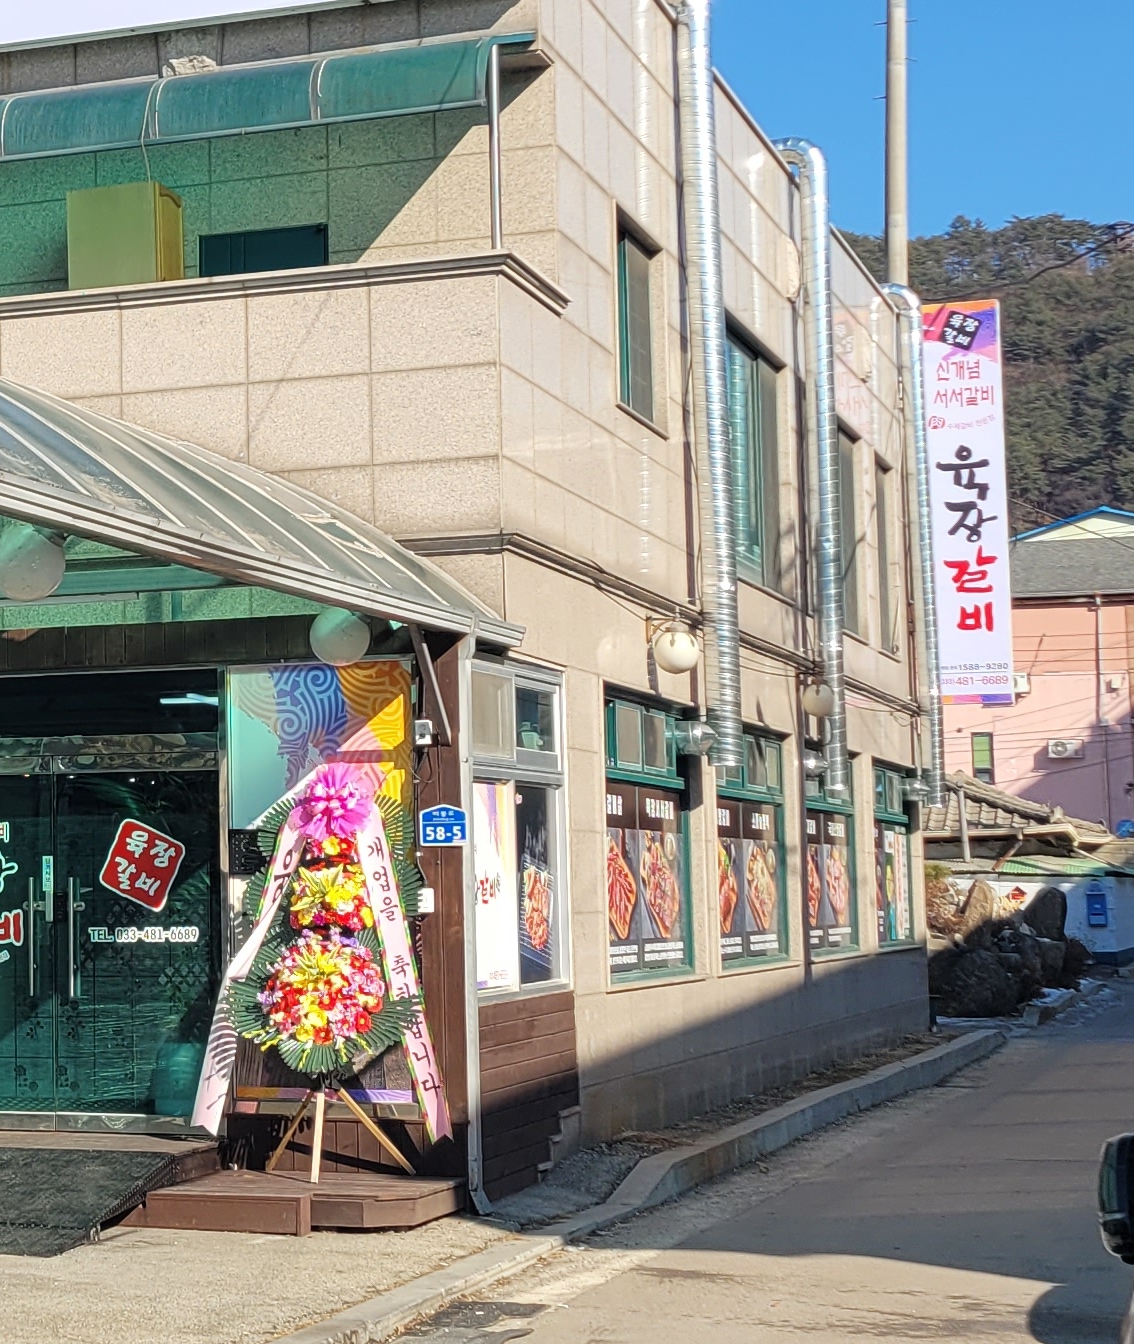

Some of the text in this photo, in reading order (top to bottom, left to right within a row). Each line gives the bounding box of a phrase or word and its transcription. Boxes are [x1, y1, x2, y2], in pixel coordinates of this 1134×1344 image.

[948, 314, 979, 332] 육장
[943, 327, 972, 346] 갈비
[936, 359, 981, 382] 신개념
[933, 385, 995, 409] 서서갈비
[936, 444, 998, 632] 육장갈비
[425, 825, 462, 841] 58-5
[125, 830, 176, 867] 육장
[114, 856, 161, 896] 갈비
[367, 836, 399, 921] 개업을
[116, 927, 199, 942] 033-481-6689
